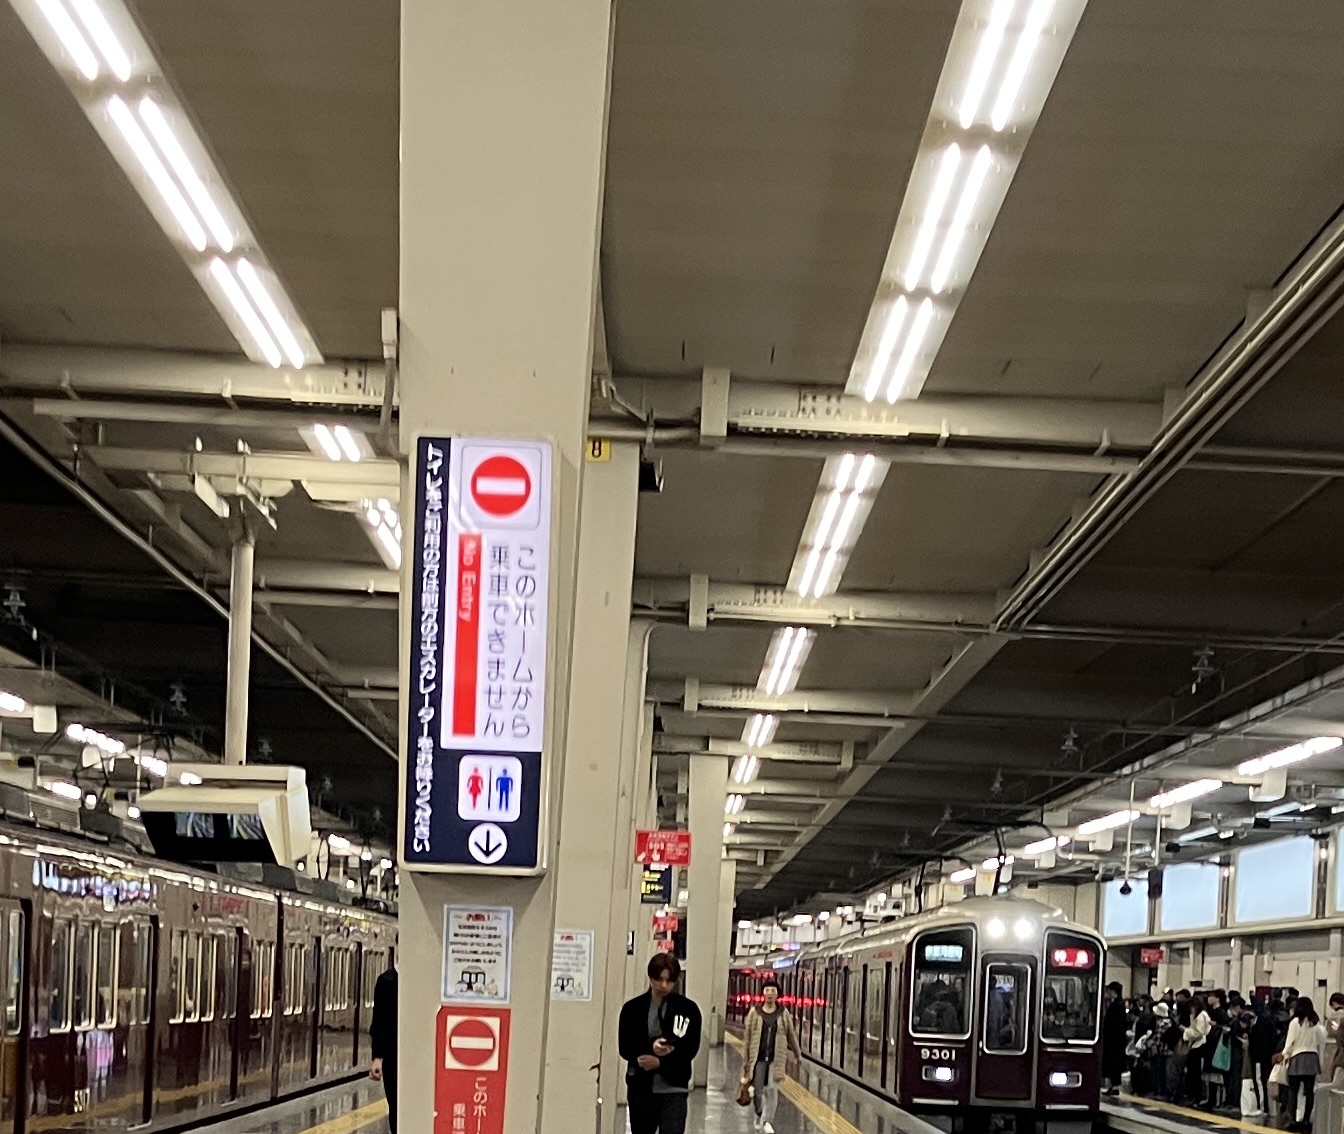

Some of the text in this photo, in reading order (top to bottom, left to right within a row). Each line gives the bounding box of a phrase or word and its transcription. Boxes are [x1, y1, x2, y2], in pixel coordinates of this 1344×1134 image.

[459, 540, 477, 622] No Entry
[484, 545, 510, 738] 乗車できません
[511, 546, 536, 738] このホームから
[920, 1048, 955, 1061] 9301
